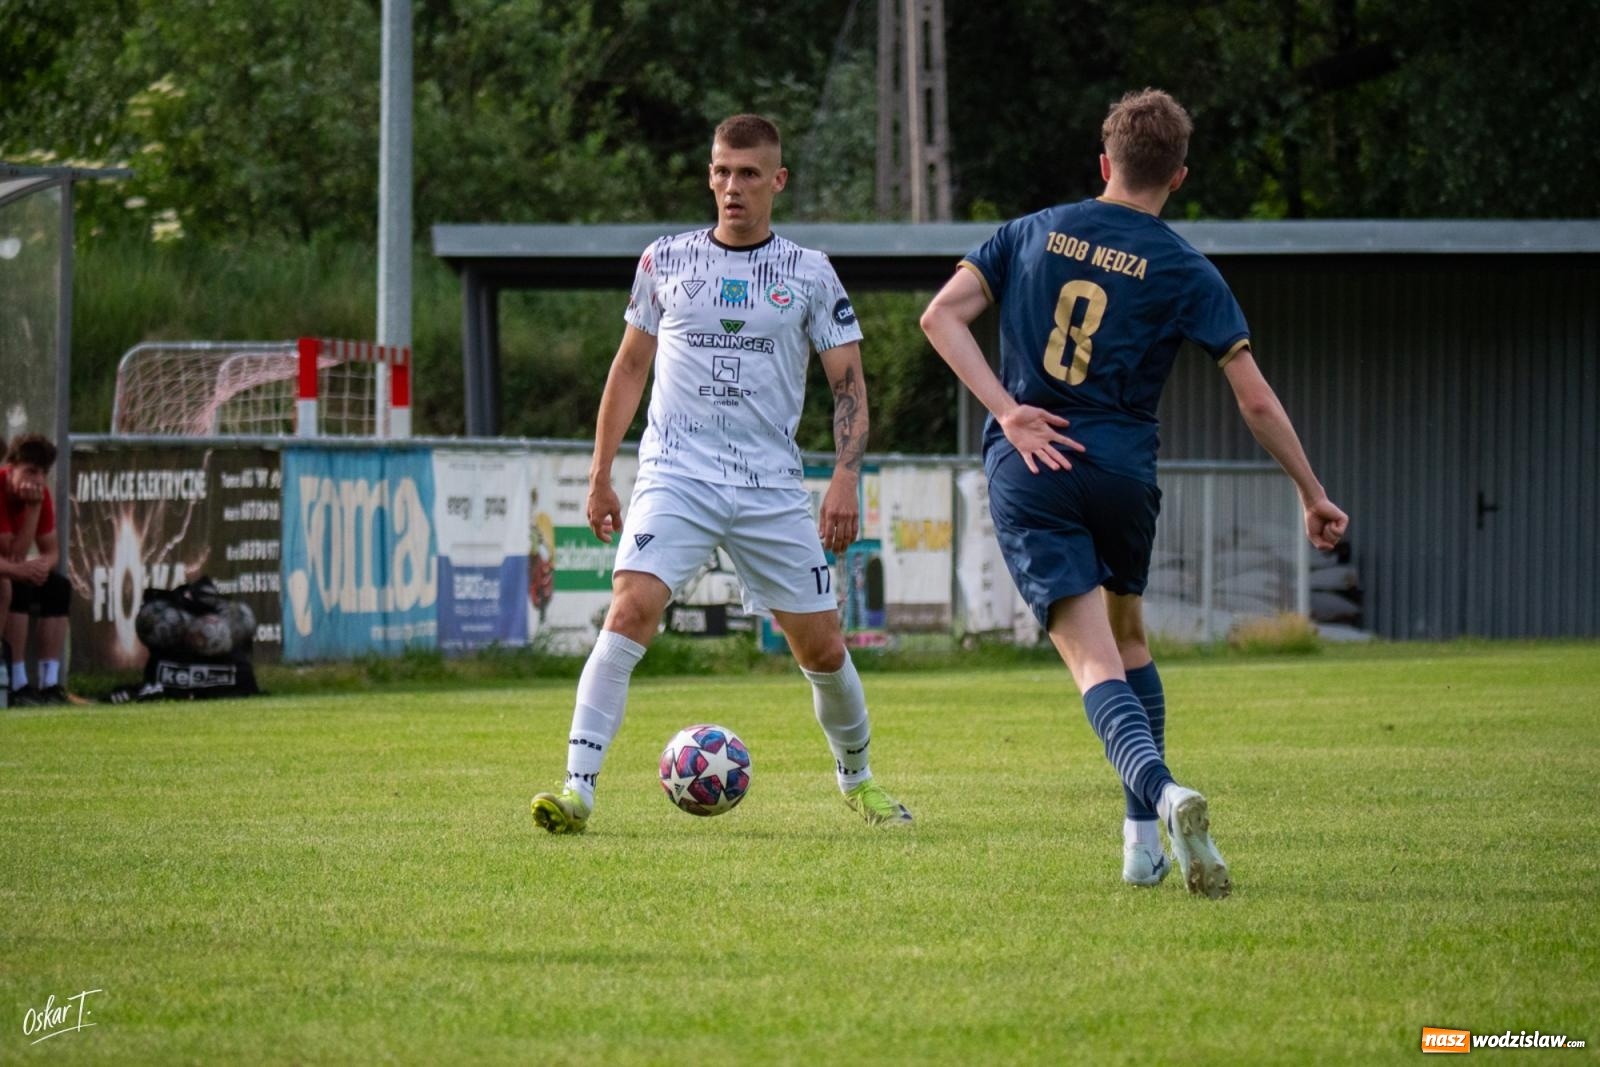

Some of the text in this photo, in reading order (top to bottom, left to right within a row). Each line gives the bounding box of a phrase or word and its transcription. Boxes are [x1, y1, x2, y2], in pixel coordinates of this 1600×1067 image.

[1046, 231, 1148, 280] 1908 NĘDZA
[687, 333, 775, 354] WENINGER
[1043, 279, 1108, 386] 8
[713, 399, 739, 407] meble
[811, 565, 830, 594] 17
